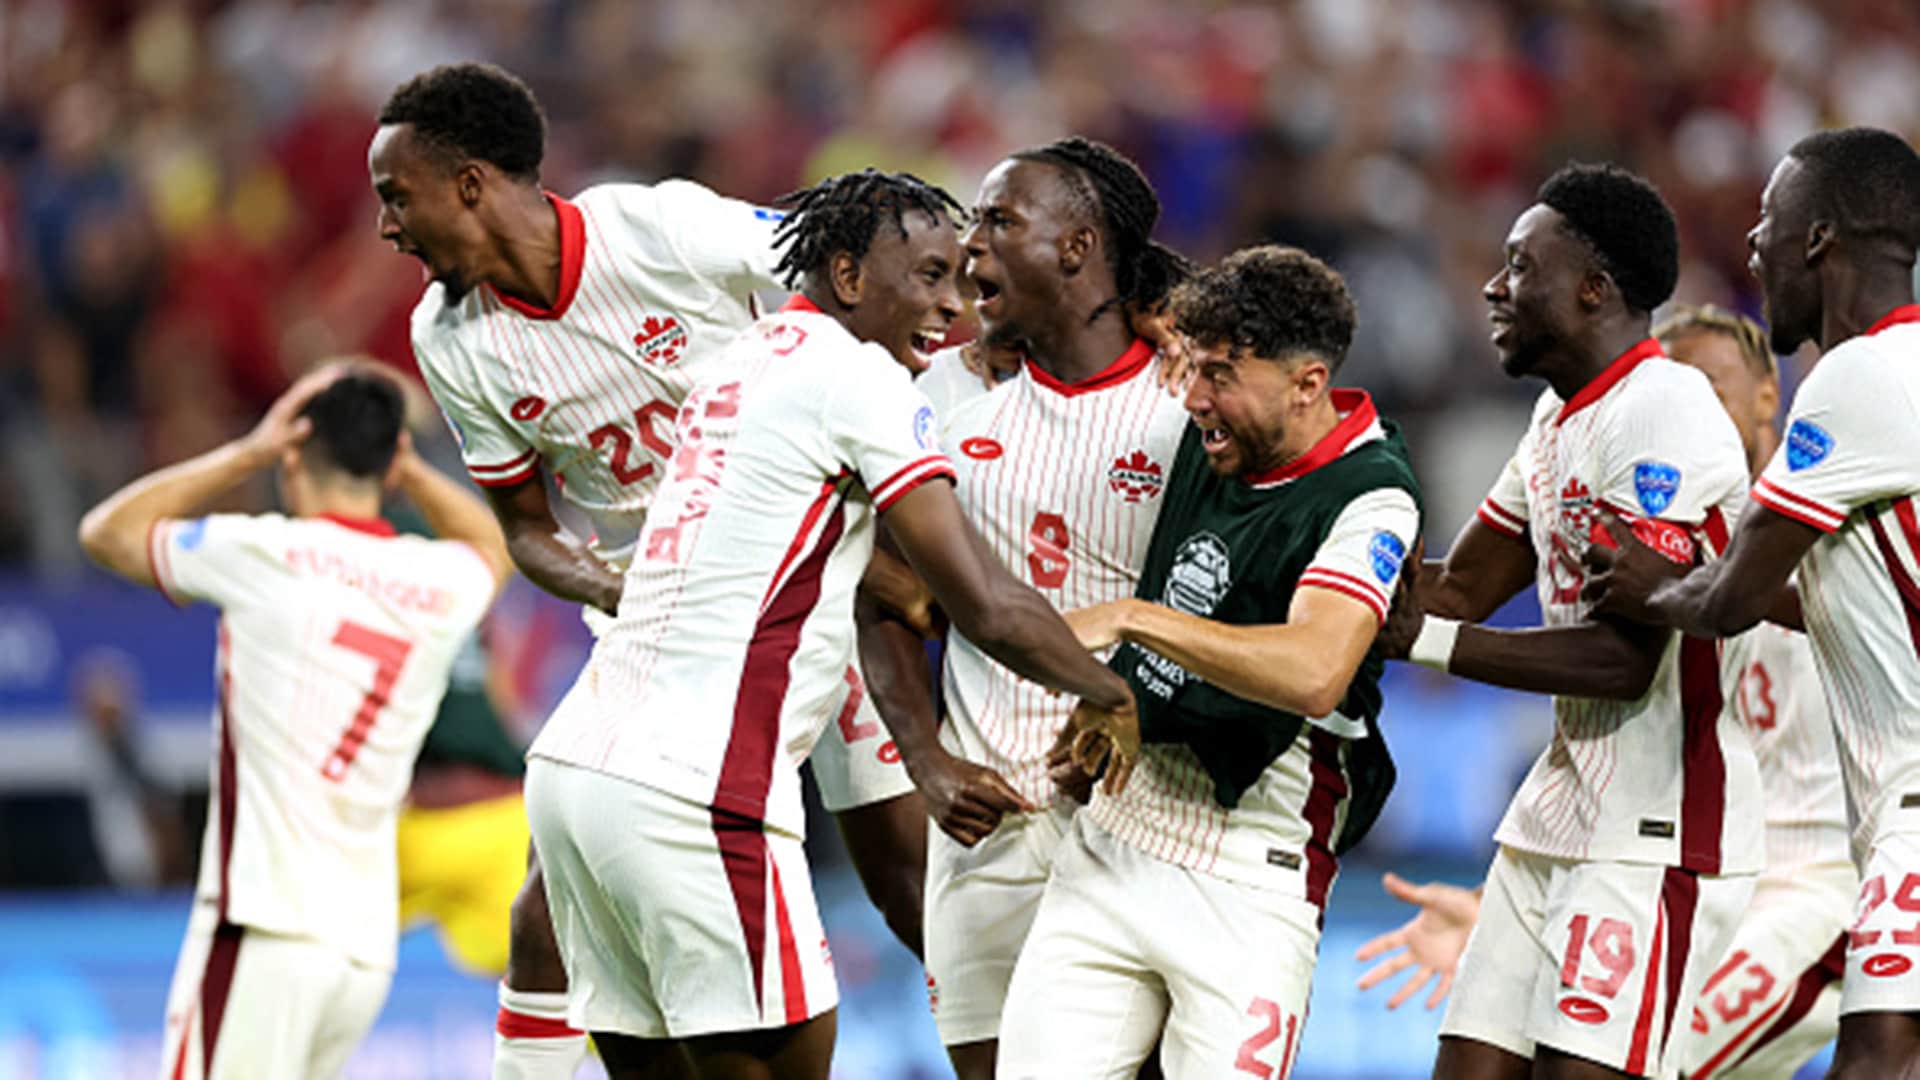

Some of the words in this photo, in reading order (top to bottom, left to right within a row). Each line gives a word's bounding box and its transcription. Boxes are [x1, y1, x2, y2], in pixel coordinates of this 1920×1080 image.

[1027, 511, 1071, 589] 8
[322, 620, 412, 784] 7
[1560, 913, 1636, 999] 19
[1700, 949, 1777, 1024] 13
[1233, 995, 1297, 1080] 21
